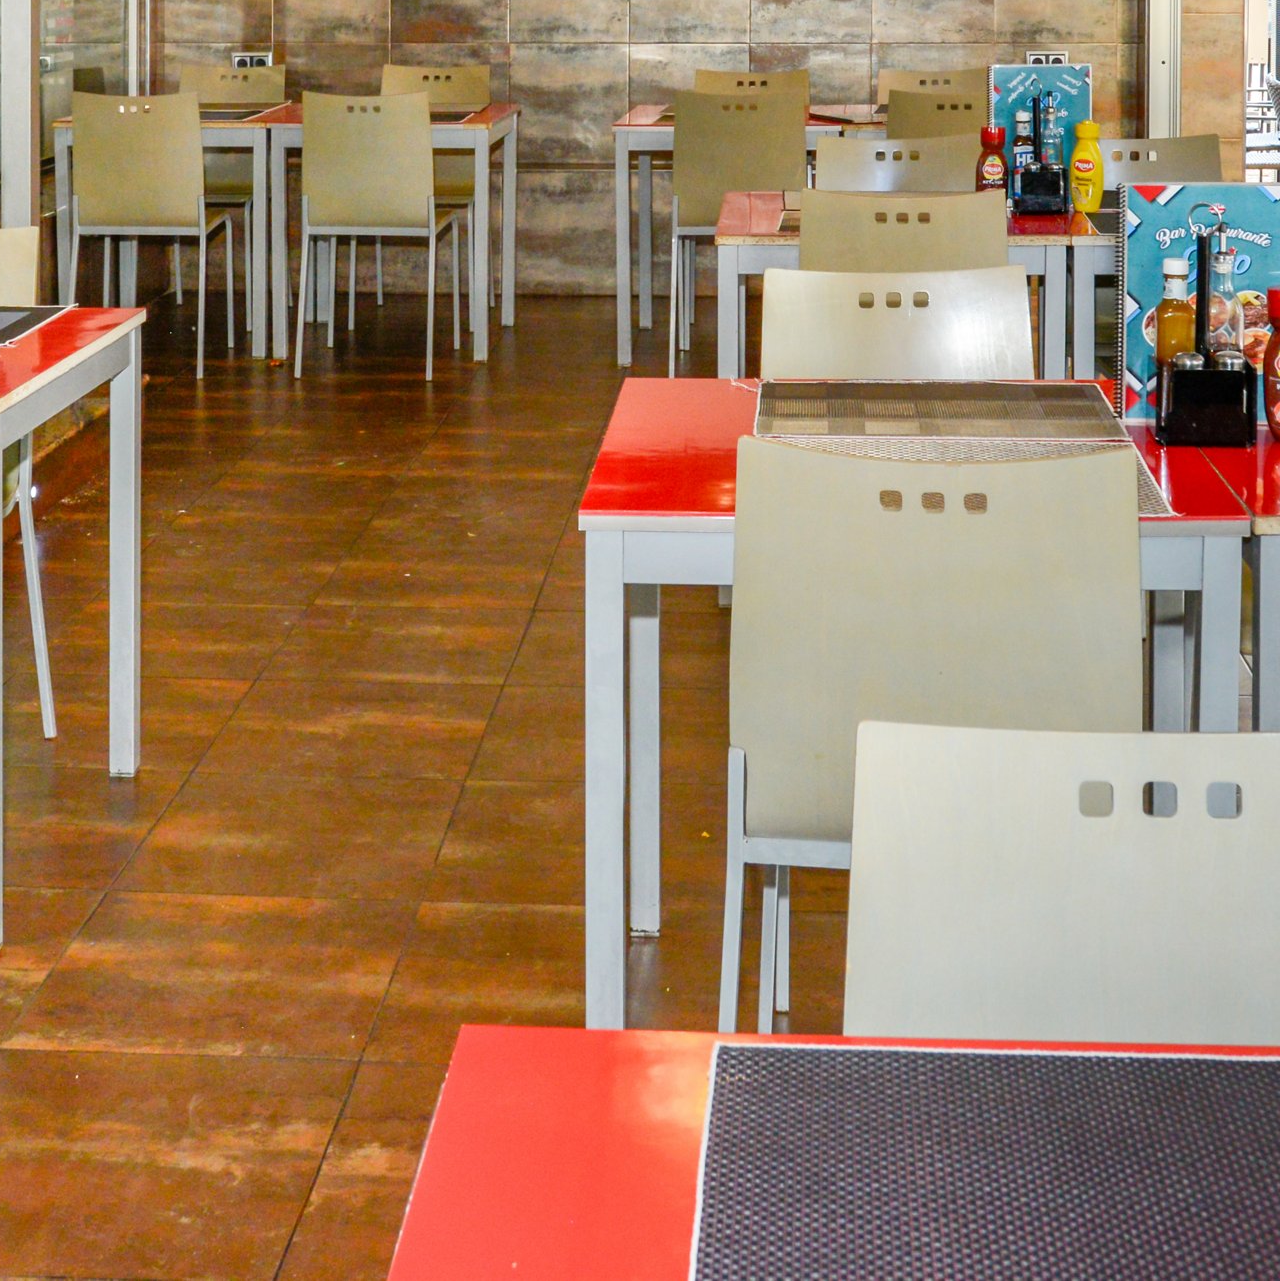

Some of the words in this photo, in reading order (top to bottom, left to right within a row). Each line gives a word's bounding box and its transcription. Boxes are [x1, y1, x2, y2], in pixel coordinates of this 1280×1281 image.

[1016, 151, 1035, 164] HP
[983, 165, 1003, 174] PRIMA
[1074, 161, 1094, 170] PRIMA
[1156, 227, 1187, 250] Bar
